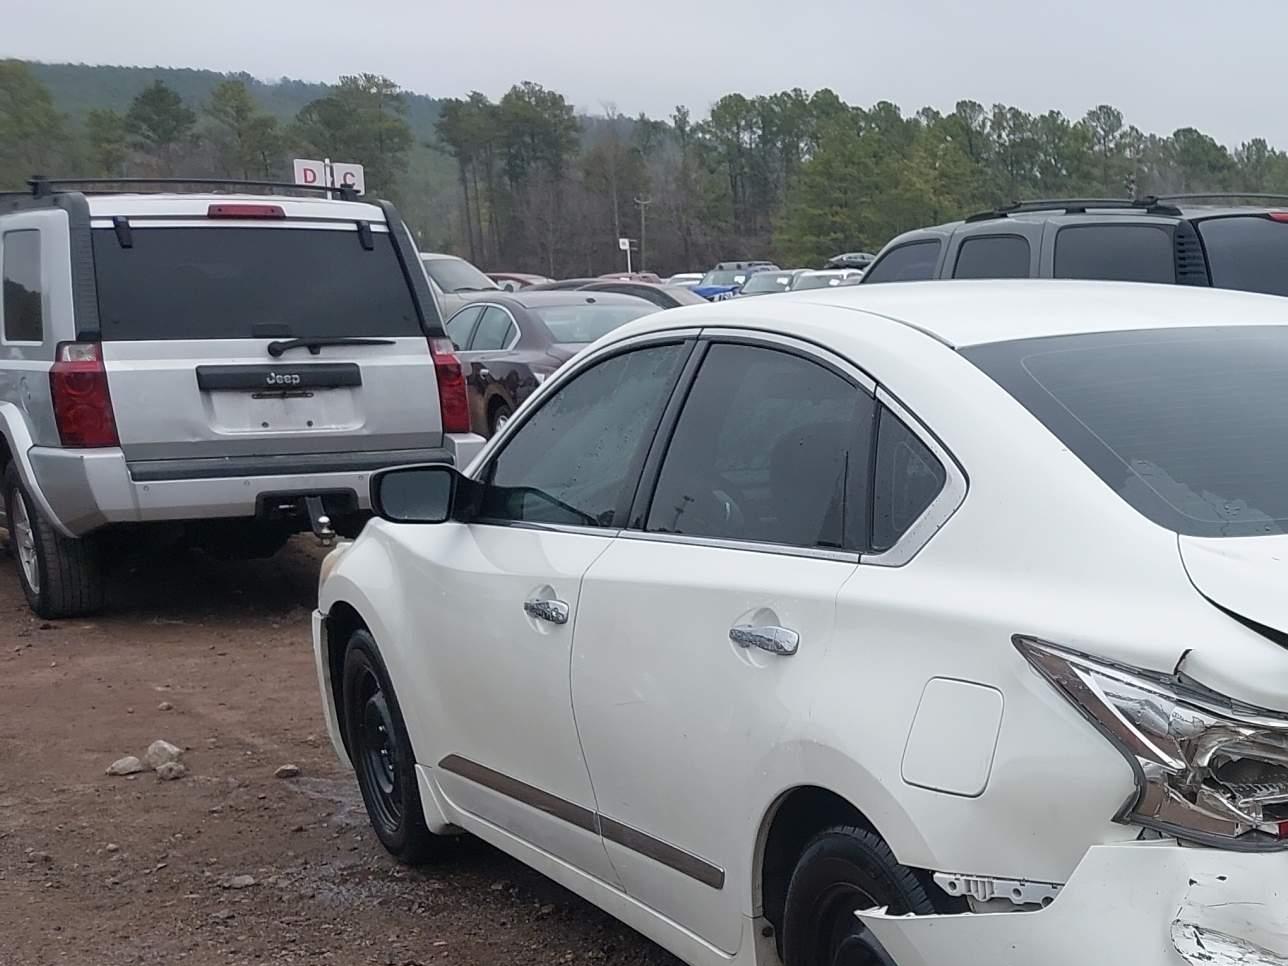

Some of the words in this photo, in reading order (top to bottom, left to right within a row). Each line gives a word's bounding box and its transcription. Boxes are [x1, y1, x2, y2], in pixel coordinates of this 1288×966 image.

[303, 168, 317, 184] D
[343, 172, 356, 186] C
[266, 372, 300, 384] Jeep
